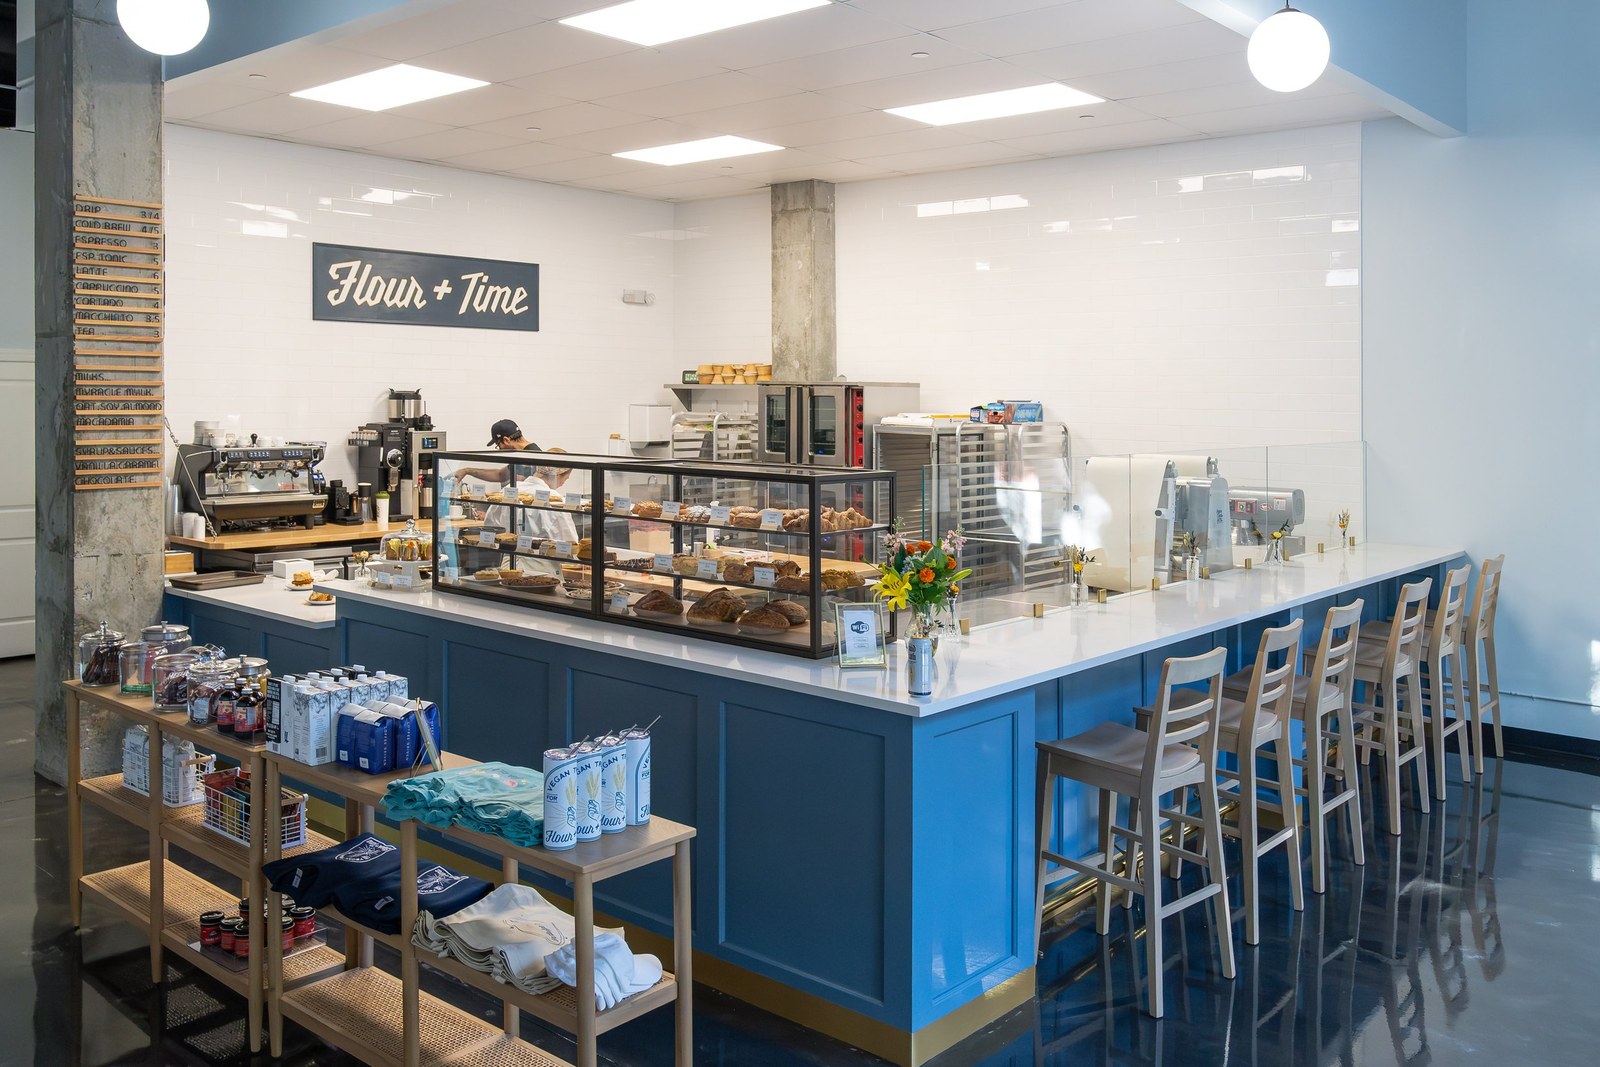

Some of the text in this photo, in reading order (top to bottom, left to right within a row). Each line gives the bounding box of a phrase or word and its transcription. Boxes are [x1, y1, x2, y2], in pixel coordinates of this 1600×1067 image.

[75, 204, 101, 213] DRIP
[75, 220, 101, 229] COLD
[104, 222, 131, 231] BREW
[75, 235, 159, 250] ESPRESSO 3
[98, 253, 128, 263] TONIC
[153, 257, 159, 265] 5
[76, 266, 108, 276] LATTE
[75, 281, 159, 295] CAPPUCCINO 5
[327, 260, 529, 315] Flour + Time
[75, 297, 159, 309] CORTADO 4
[75, 311, 160, 323] MACCHIATO 3.5
[153, 330, 160, 338] 3
[76, 417, 135, 426] MACADAMIA
[547, 769, 571, 792] VEGAN
[601, 814, 621, 826] lour
[577, 824, 594, 835] our
[545, 830, 573, 844] Flour
